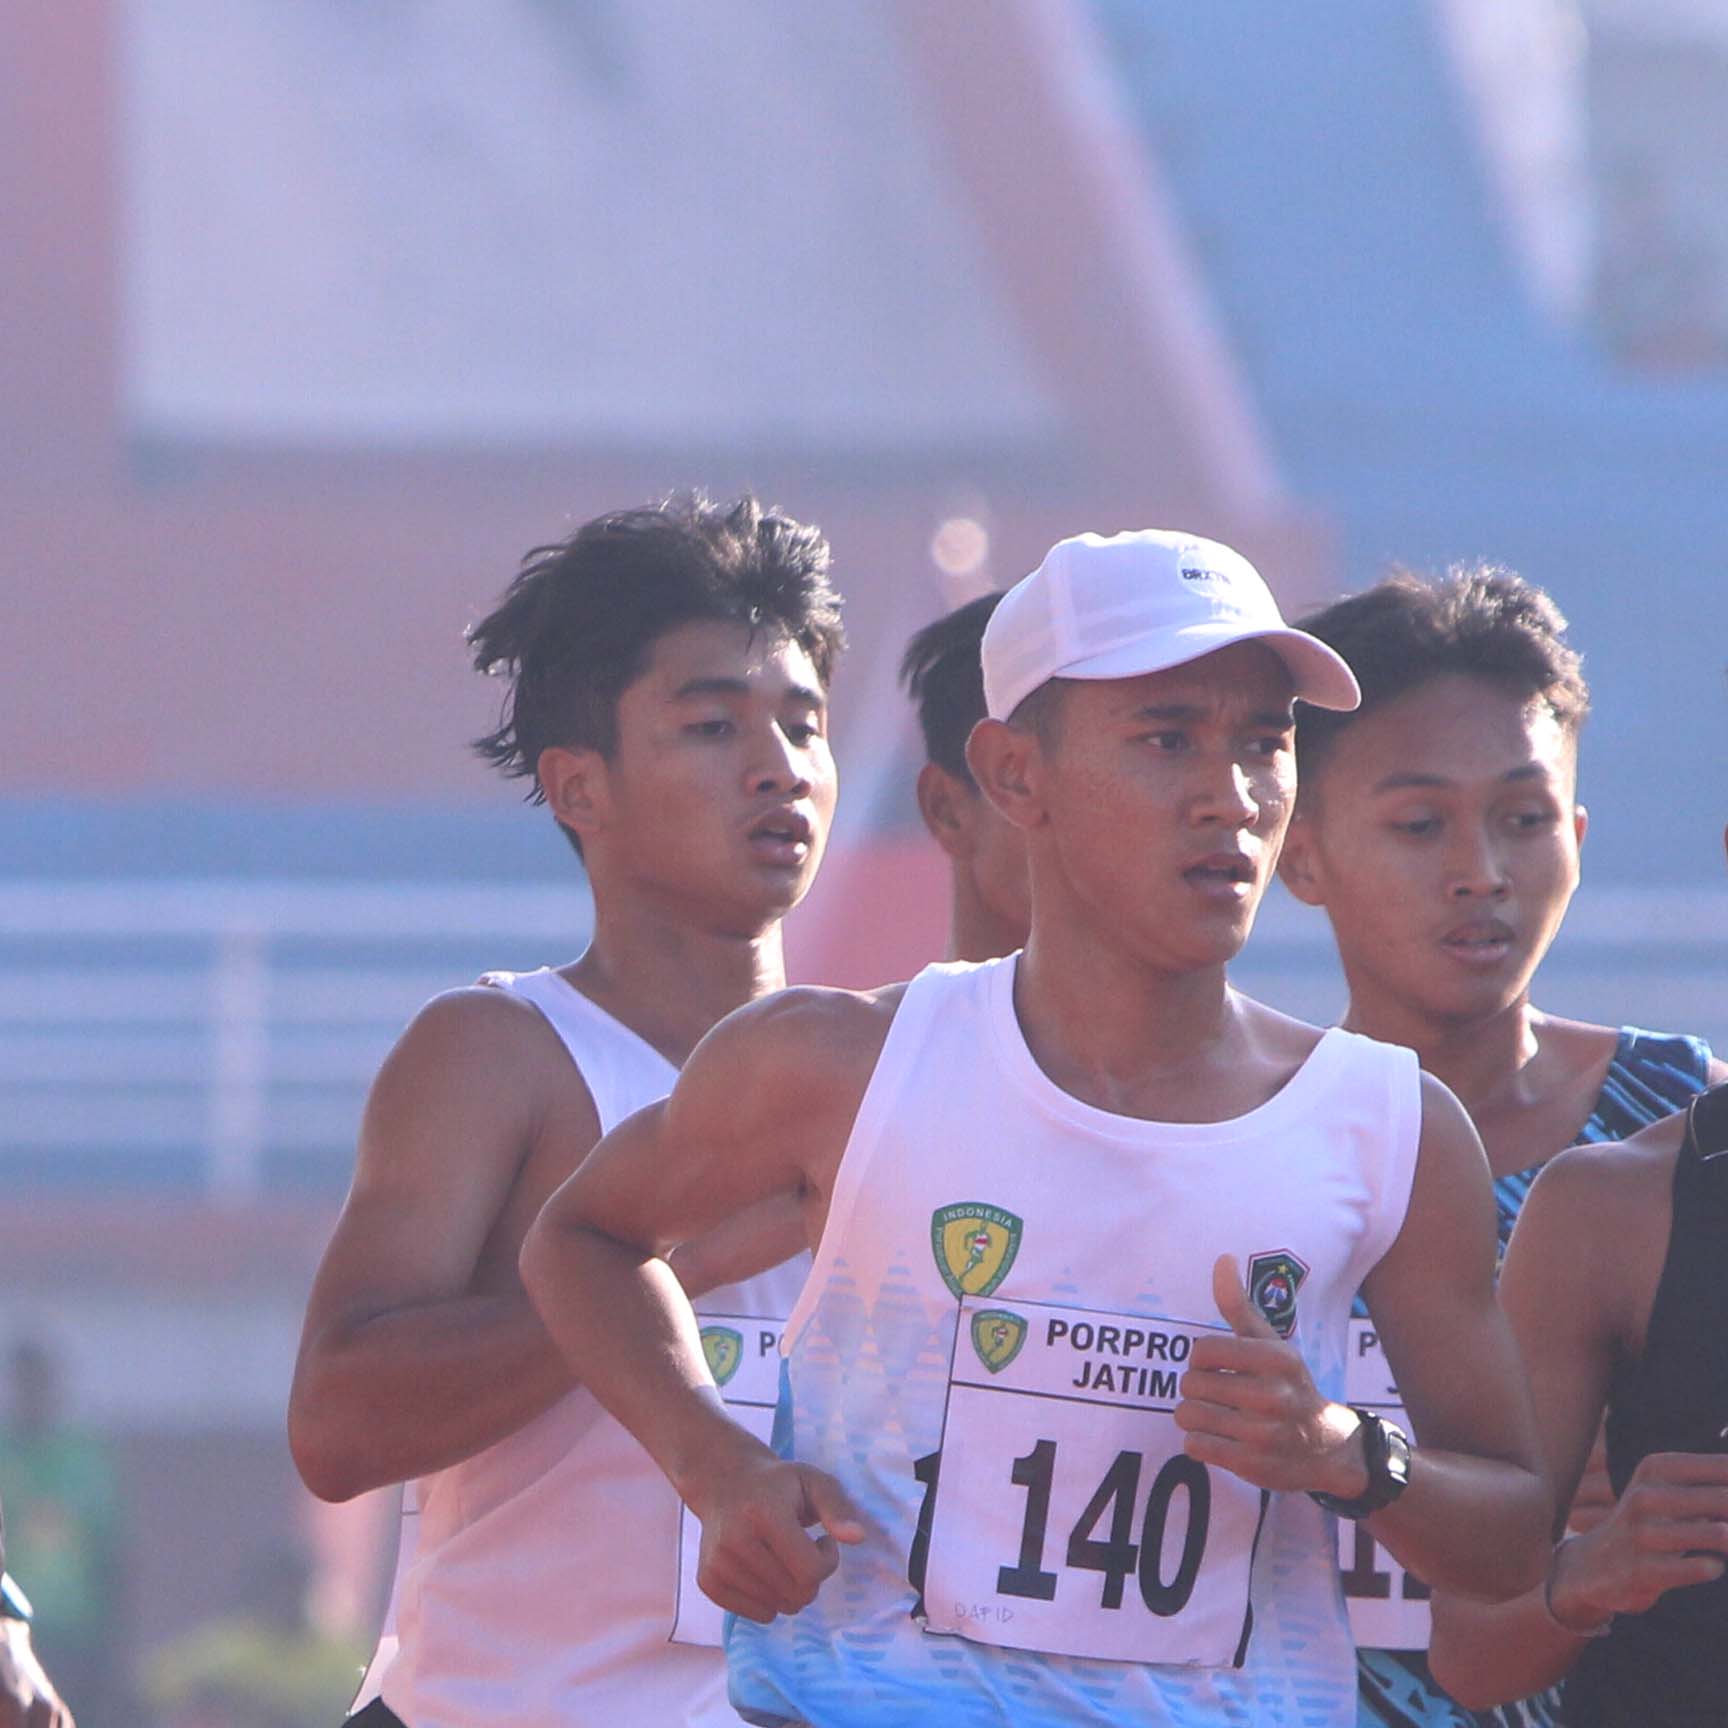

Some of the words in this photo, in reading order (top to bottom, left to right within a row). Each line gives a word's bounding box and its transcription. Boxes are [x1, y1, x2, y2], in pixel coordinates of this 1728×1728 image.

[943, 1206, 1013, 1228] INDONESIA
[1046, 1318, 1199, 1363] PORPRO
[1072, 1361, 1178, 1400] JATIM
[995, 1438, 1212, 1617] 140
